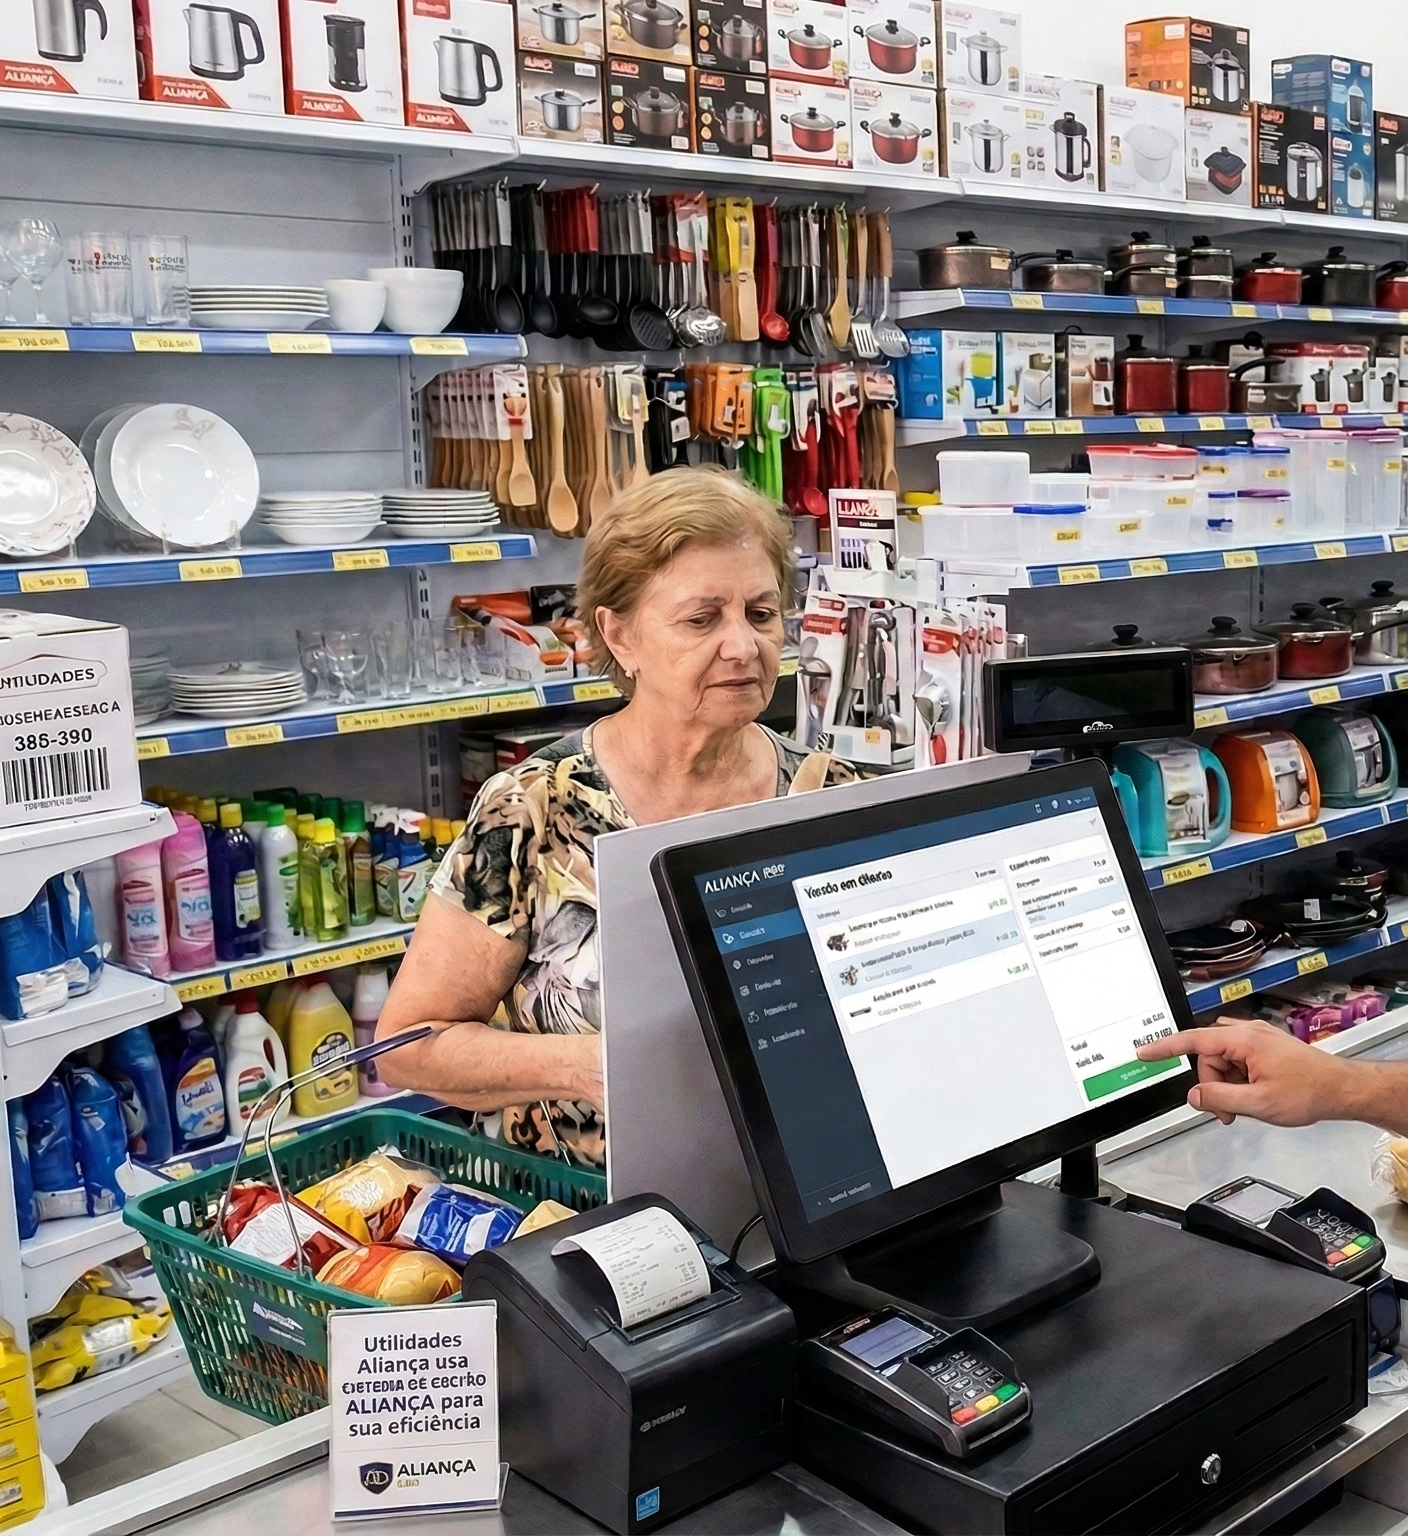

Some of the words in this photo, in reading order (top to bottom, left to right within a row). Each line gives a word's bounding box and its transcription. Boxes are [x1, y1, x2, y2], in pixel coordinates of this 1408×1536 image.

[704, 870, 760, 894] ALIANÇA
[364, 1332, 463, 1353] Utilidades
[357, 1357, 430, 1375] Aliança
[435, 1355, 469, 1370] usa
[346, 1395, 435, 1416] ALIANÇA
[441, 1394, 484, 1414] para
[349, 1422, 383, 1437] sua
[388, 1413, 481, 1434] eficiência
[397, 1459, 477, 1478] ALIANÇA
